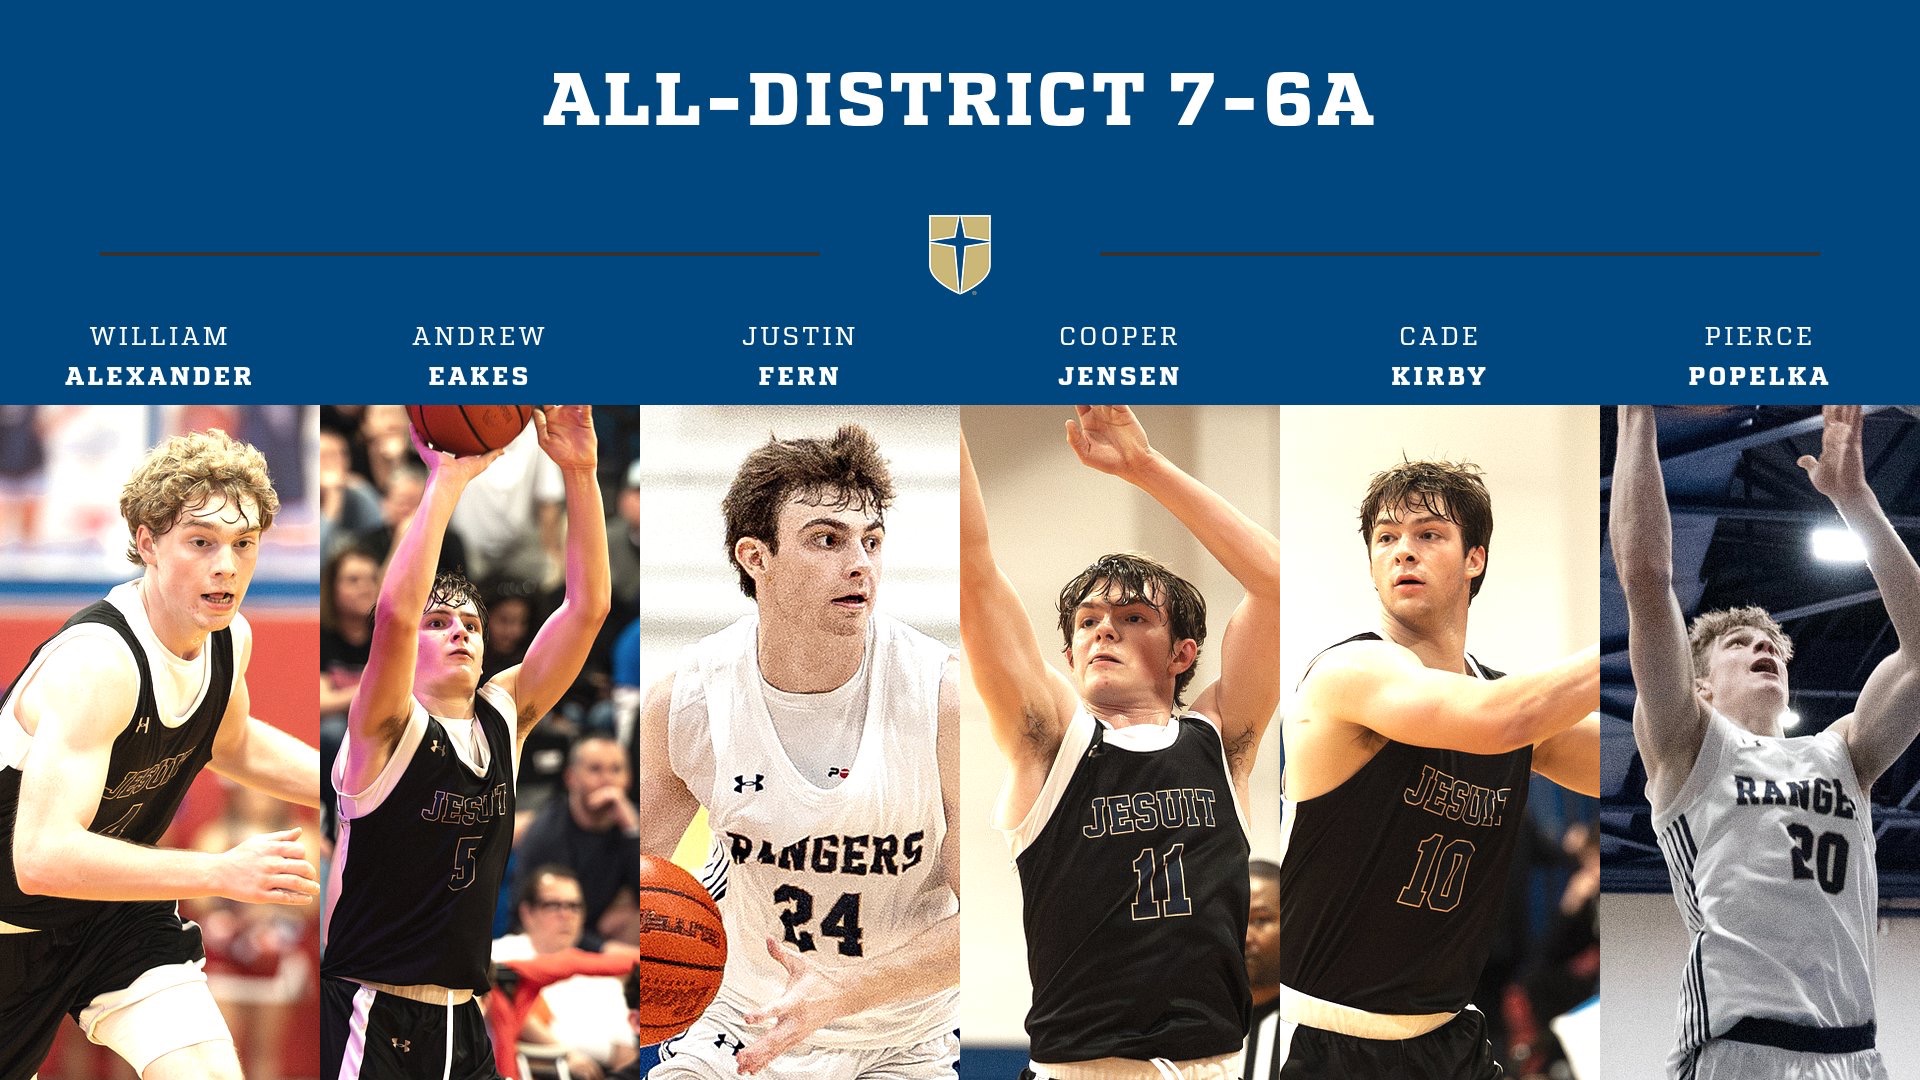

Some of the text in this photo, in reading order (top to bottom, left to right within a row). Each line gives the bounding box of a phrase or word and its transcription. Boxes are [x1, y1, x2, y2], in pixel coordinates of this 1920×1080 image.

[1082, 787, 1217, 839] JESUIT
[1734, 774, 1857, 820] RANGE
[447, 835, 483, 892] 5
[725, 829, 925, 877] RANGERS
[1131, 843, 1193, 921] 11
[1396, 833, 1476, 913] 10
[1786, 822, 1850, 895] 20
[773, 883, 864, 958] 24
